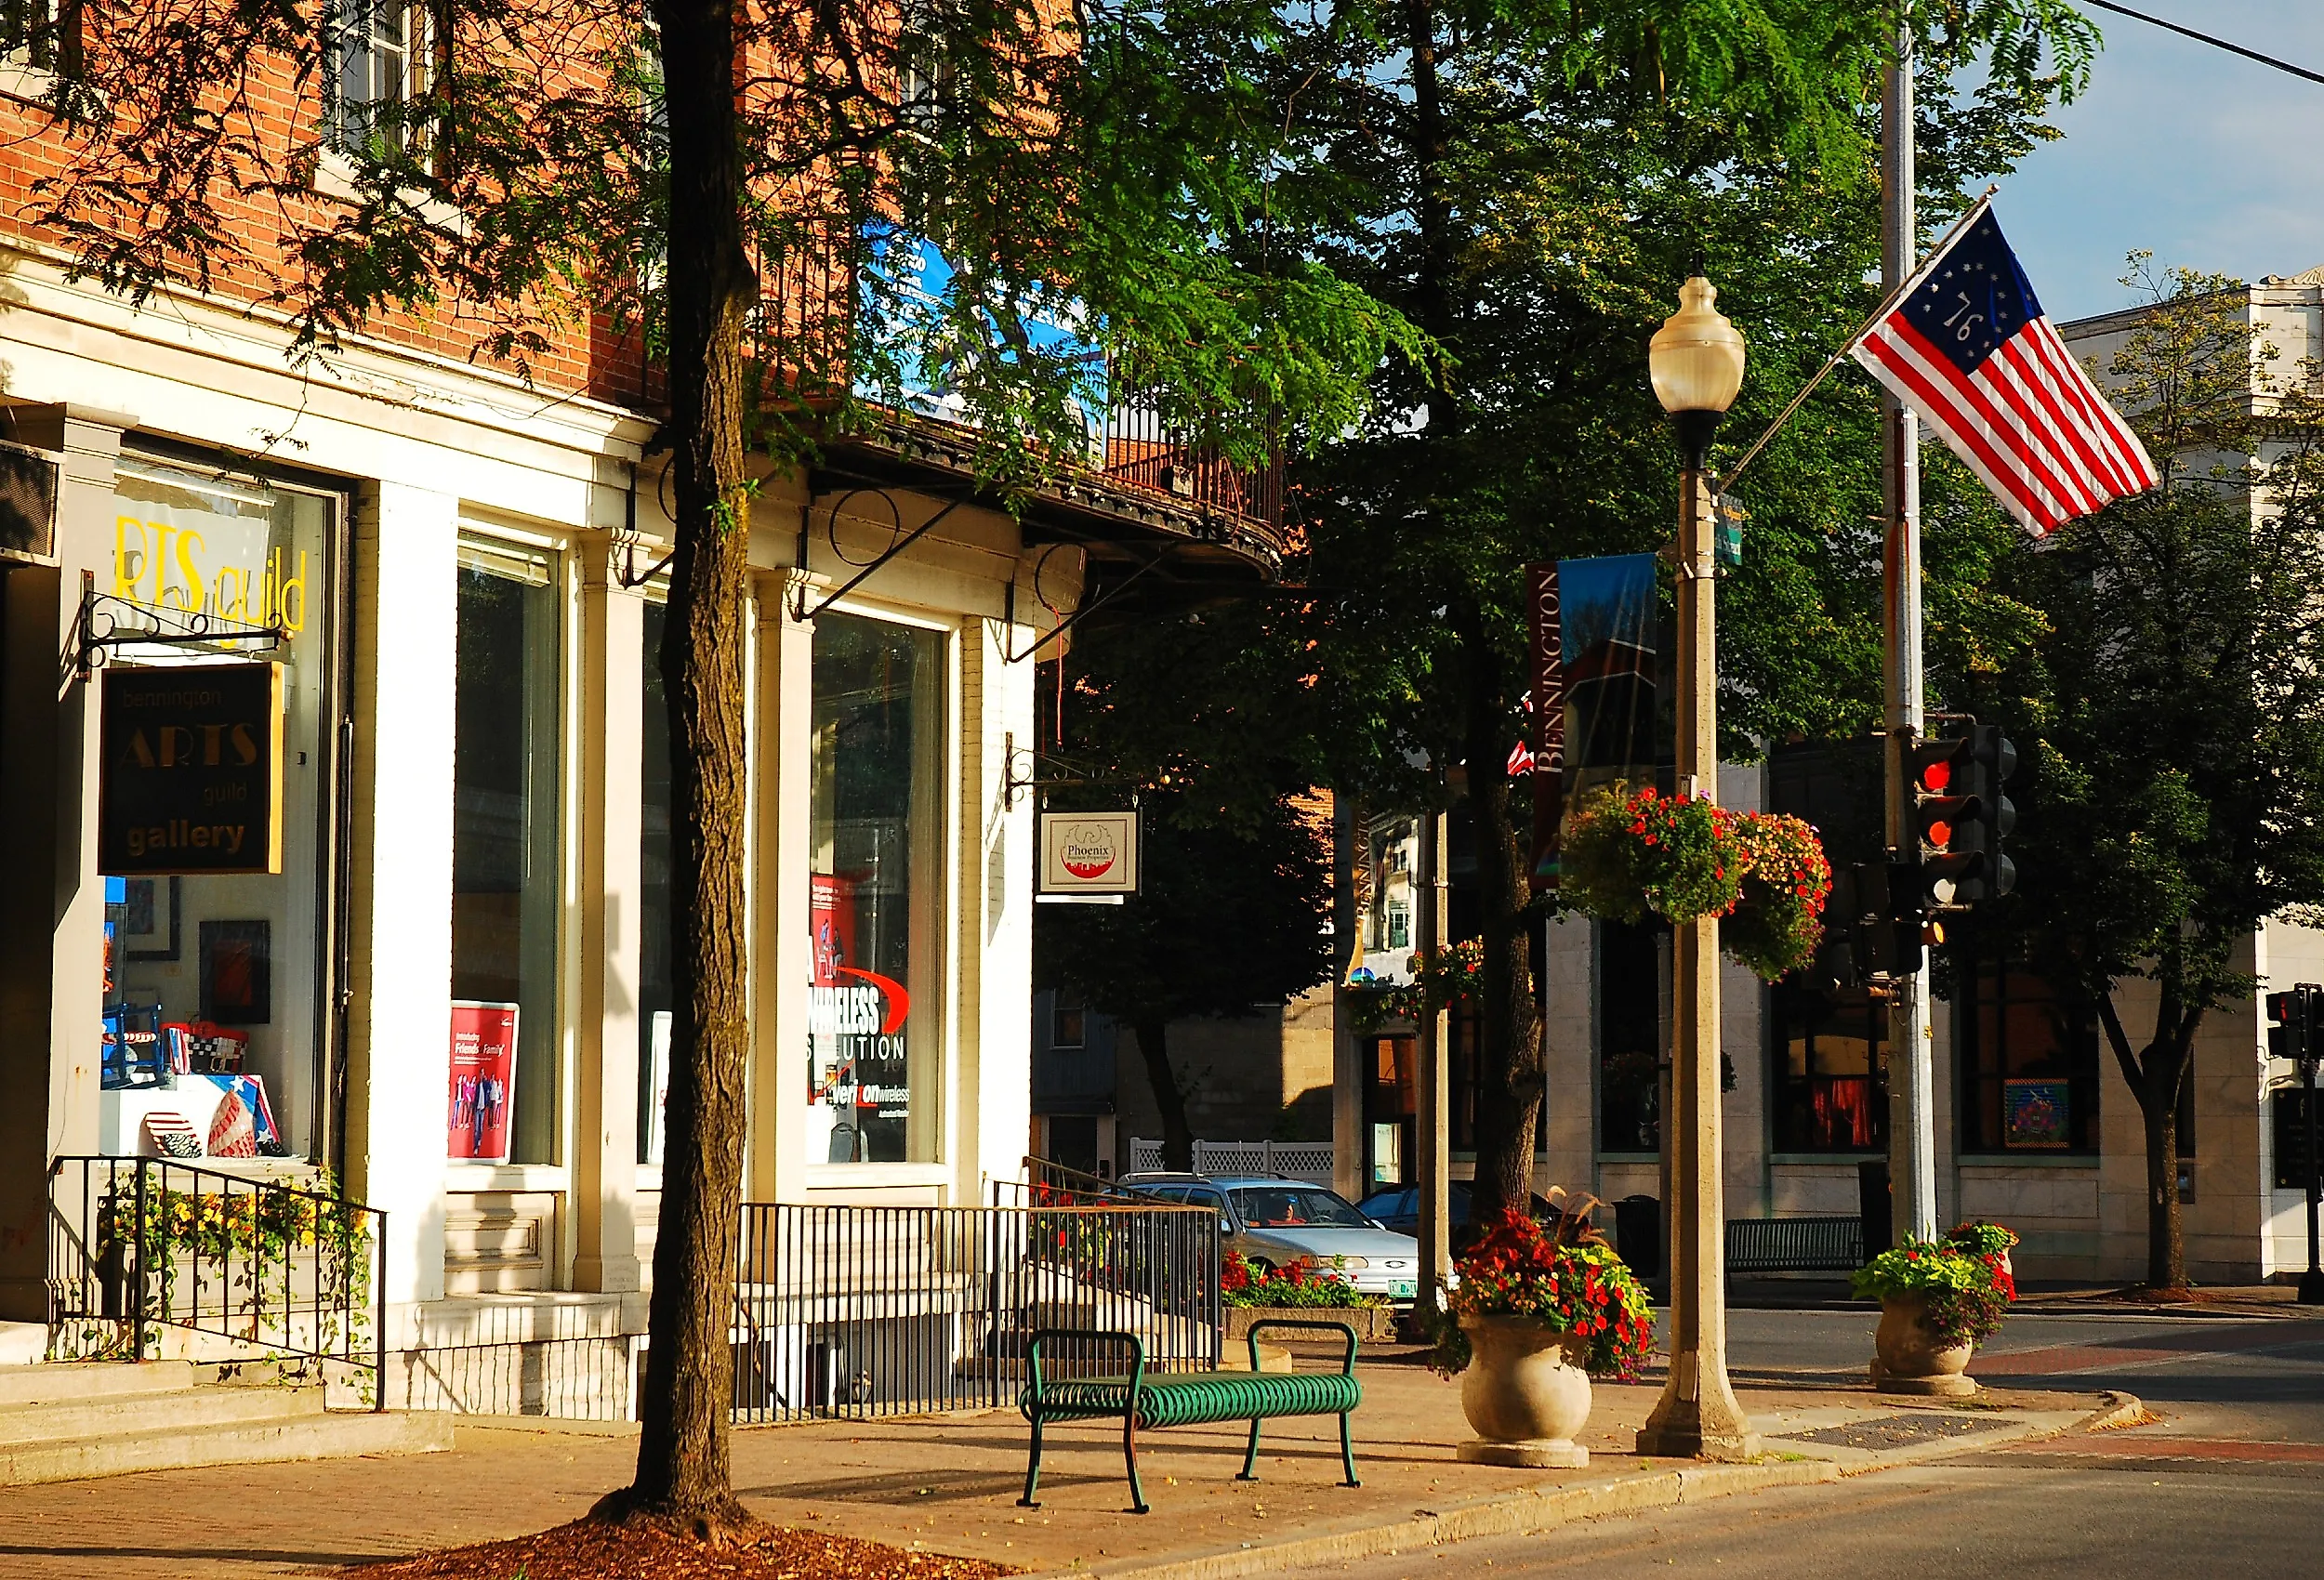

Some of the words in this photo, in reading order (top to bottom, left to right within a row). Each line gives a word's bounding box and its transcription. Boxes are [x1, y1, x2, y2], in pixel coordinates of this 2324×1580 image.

[215, 546, 306, 650] guild
[1537, 570, 1565, 773] BENNINGTON
[123, 688, 222, 710] bennington
[119, 722, 257, 769] ARTS
[204, 782, 248, 808] guild
[126, 818, 246, 857] gallery
[1068, 844, 1109, 856] Phoenix
[1356, 808, 1372, 920] BENNINGTO
